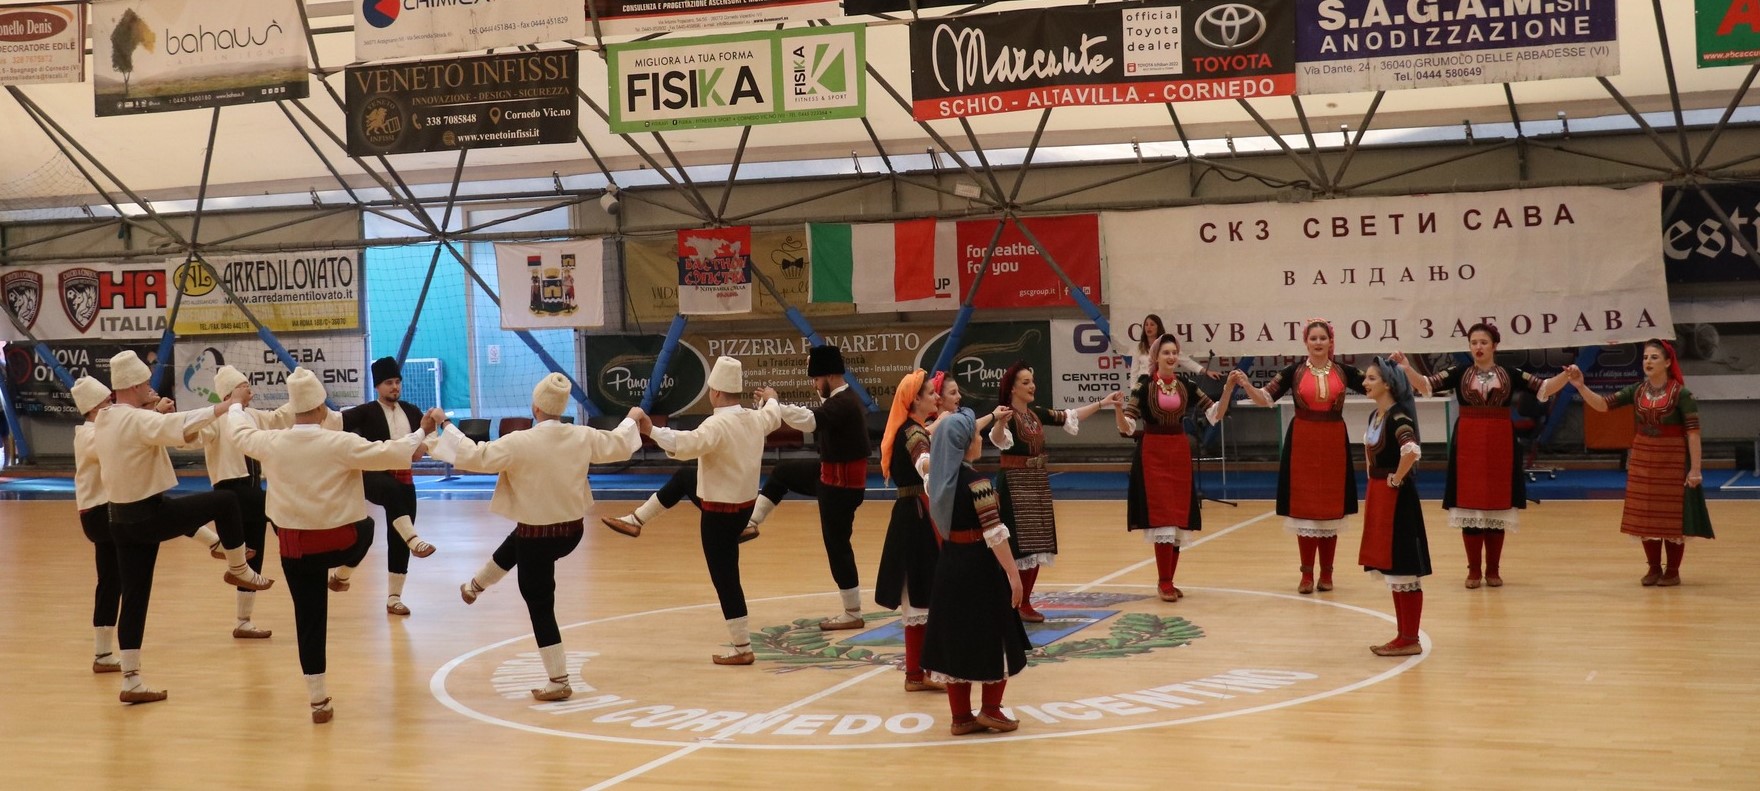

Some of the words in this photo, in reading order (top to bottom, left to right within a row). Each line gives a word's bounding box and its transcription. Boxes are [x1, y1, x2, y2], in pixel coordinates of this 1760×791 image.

[622, 3, 657, 12] CONSULENZA
[662, 0, 707, 10] PROGETTAZIONE
[1125, 10, 1178, 22] official
[27, 18, 52, 34] Denis
[520, 21, 530, 29] fax
[1126, 26, 1178, 37] Toyota
[1319, 17, 1591, 54] ANODIZZAZIONE
[53, 41, 76, 51] EDILE
[1127, 41, 1179, 52] dealer
[634, 54, 680, 68] MIGLIORA
[683, 53, 696, 64] LA
[698, 52, 716, 63] TUA
[719, 50, 754, 61] FORMA
[1191, 53, 1273, 73] TOYOTA
[1303, 65, 1320, 75] Via
[1380, 59, 1412, 70] 36040
[1414, 54, 1473, 68] GRUMOLO
[1476, 51, 1514, 64] DELLE
[1516, 47, 1587, 62] ABBADESSE
[1589, 45, 1610, 58] (VI)
[354, 63, 464, 95] VENETO
[472, 54, 569, 87] INFISSI
[792, 45, 807, 96] FISIKA
[1393, 71, 1413, 82] Tel.
[1415, 69, 1442, 81] 0444
[1445, 67, 1482, 79] 580649
[411, 93, 472, 106] INNOVAZIONE
[478, 90, 512, 100] DESIGN
[518, 87, 570, 99] SICUREZZA
[627, 65, 764, 112] FISIKA
[794, 95, 819, 103] FITNESS
[827, 93, 848, 101] SPORT
[939, 95, 1003, 118] SCHIO
[1026, 86, 1140, 109] ALTAVILLA
[1163, 78, 1275, 102] CORNEDO
[426, 116, 441, 126] 338
[443, 113, 477, 125] 7085848
[504, 109, 541, 120] Cornedo
[543, 107, 571, 118] Vic.no
[457, 128, 540, 142] www.venetoinfissi.it
[1199, 219, 1270, 243] СКЗ
[1302, 211, 1437, 239] СВЕТИ
[1463, 203, 1575, 231] САВА
[966, 260, 985, 274] fo
[992, 260, 1019, 276] you
[1283, 263, 1476, 287] ВАЛДАЊО
[98, 269, 167, 309] HA
[224, 288, 353, 305] ww.arredamentilovato.it
[1019, 287, 1056, 297] gscgroup.it
[100, 315, 168, 332] ITALIA
[1127, 320, 1331, 343] СЧУВАТ
[1351, 318, 1400, 343] ОД
[708, 338, 797, 357] PIZZERIA
[800, 332, 920, 355] PNARETTO
[34, 349, 90, 366] NOVA
[263, 348, 326, 364] CS.BA
[757, 358, 768, 367] La
[323, 368, 359, 384] SNC
[741, 368, 767, 378] gionali
[771, 367, 790, 375] Pizze
[874, 363, 913, 373] Insalatone
[607, 366, 674, 391] Panato
[744, 379, 762, 387] Primi
[768, 379, 795, 387] Secondi
[865, 377, 882, 385] casa
[1062, 372, 1120, 382] CENTRO
[1078, 383, 1121, 392] MOTO
[1088, 395, 1105, 403] Orti
[592, 704, 935, 736] CORNEDO
[971, 668, 1319, 725] ICENTINO
